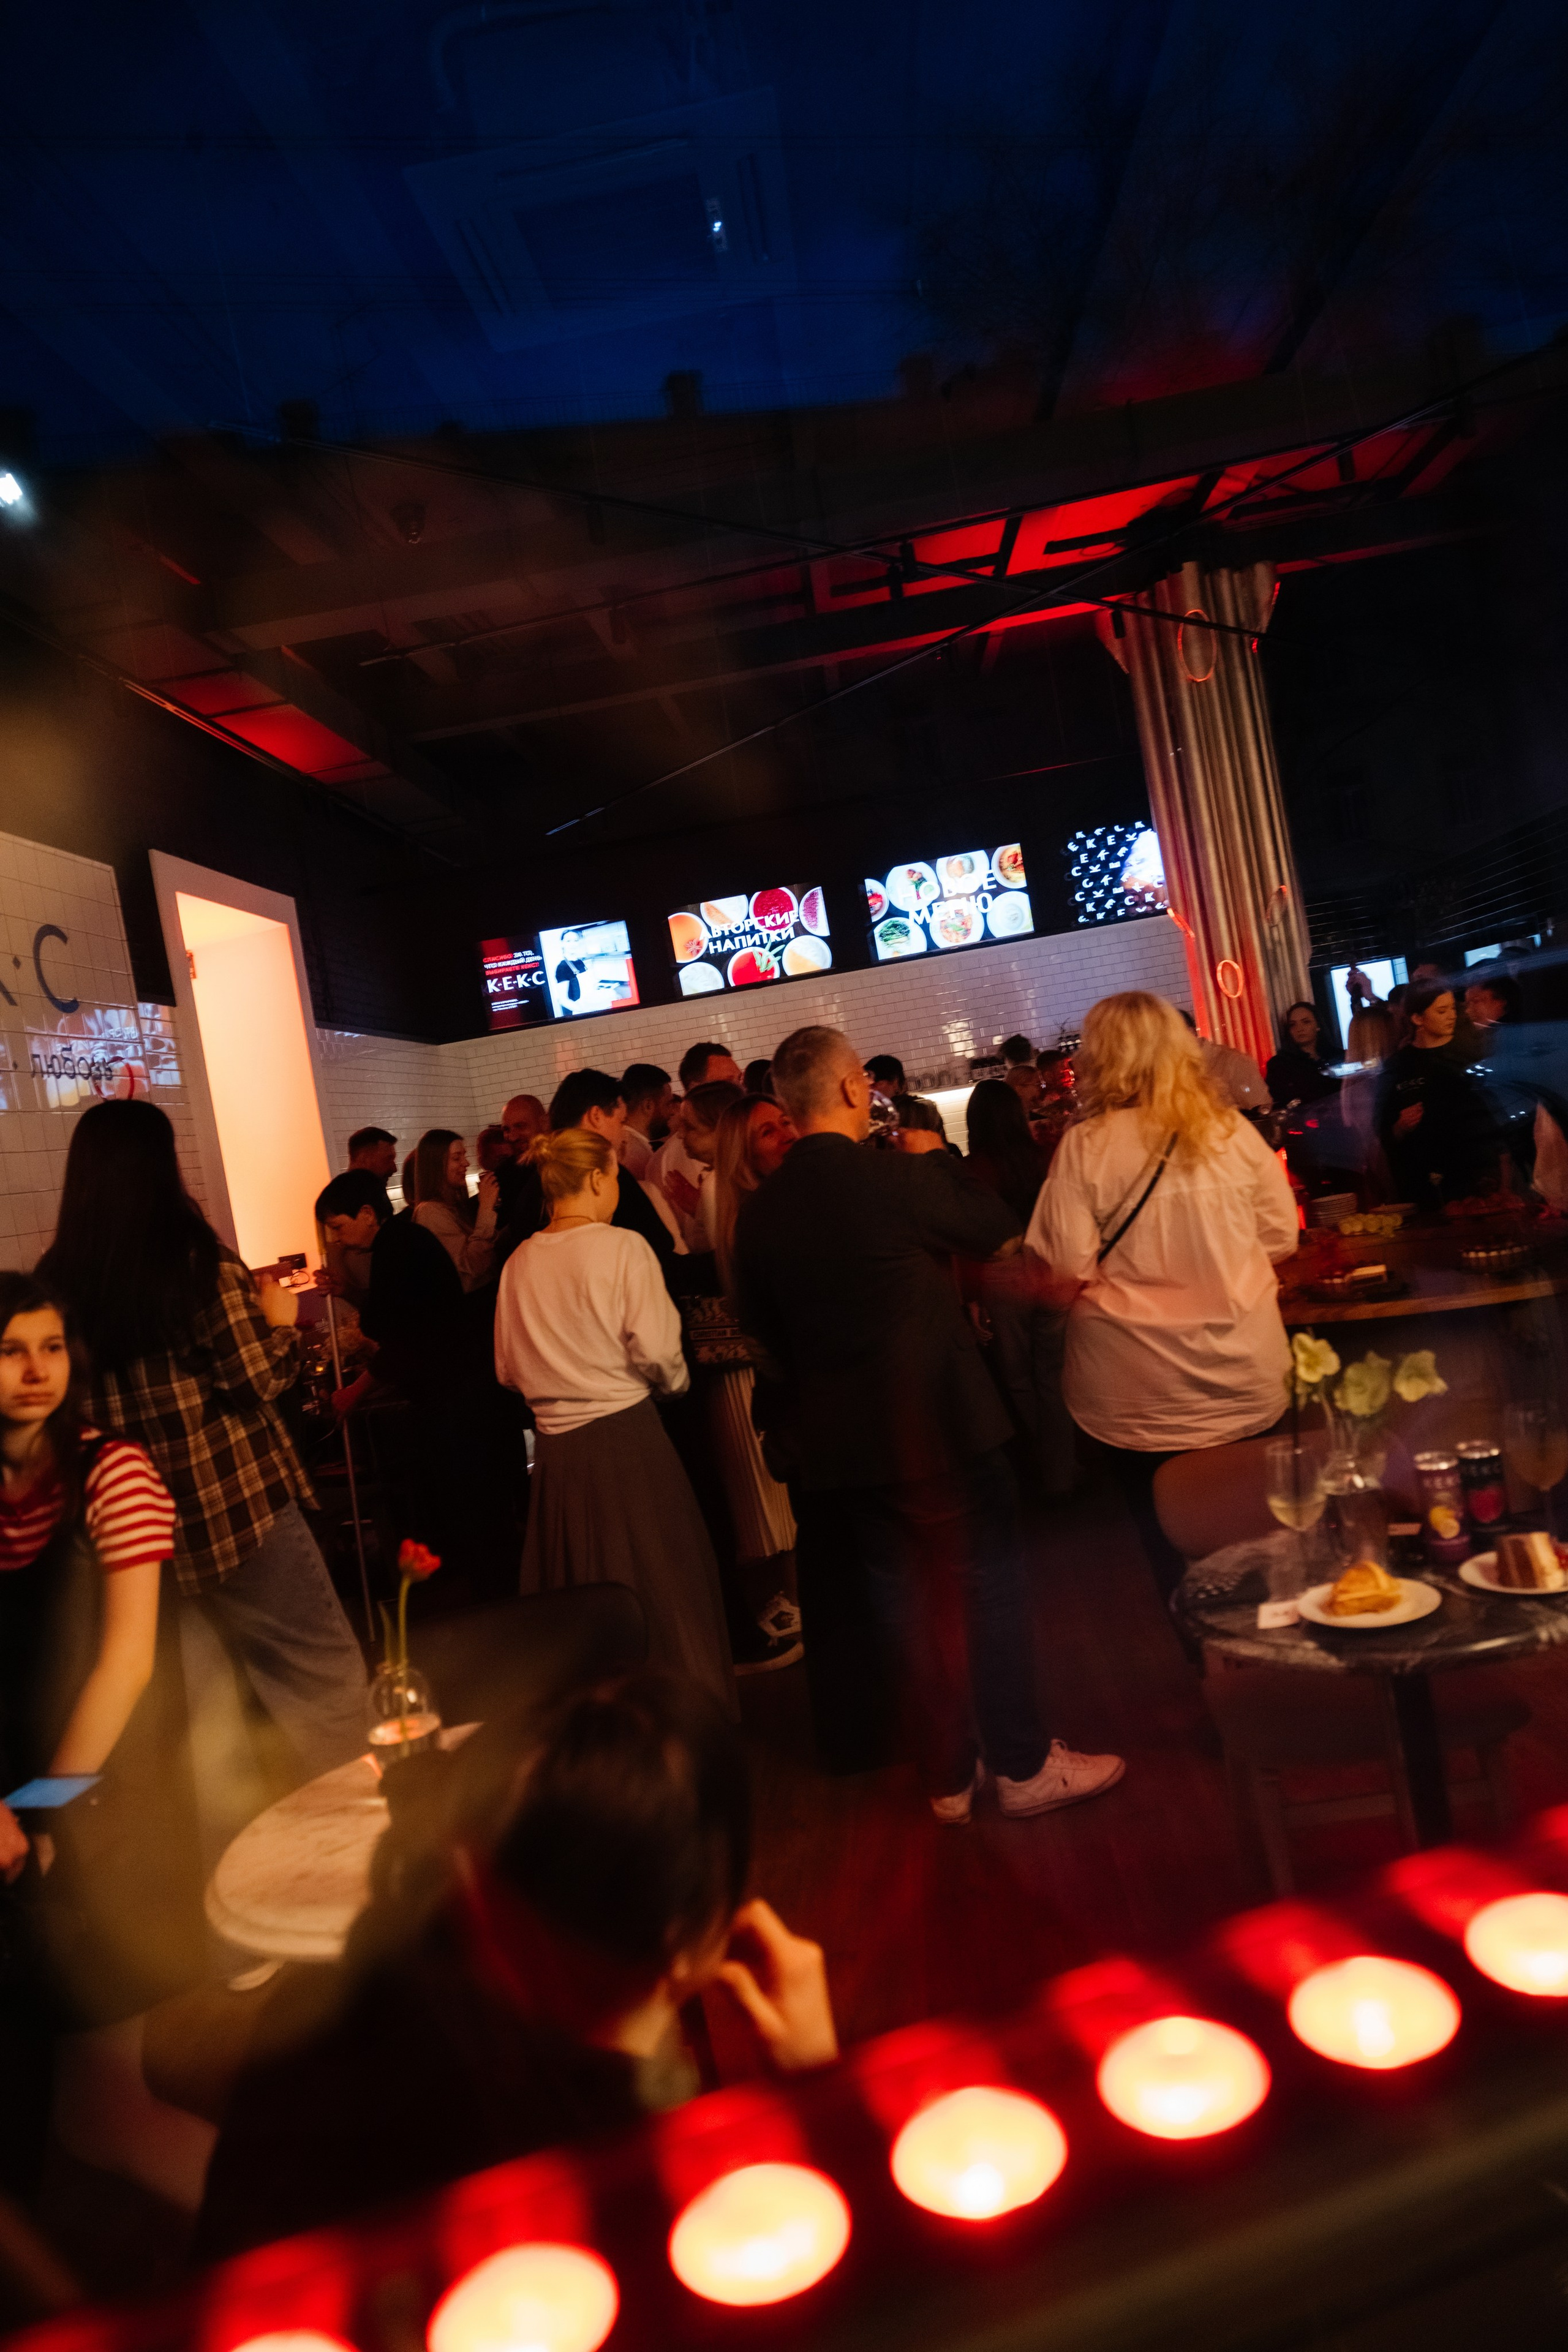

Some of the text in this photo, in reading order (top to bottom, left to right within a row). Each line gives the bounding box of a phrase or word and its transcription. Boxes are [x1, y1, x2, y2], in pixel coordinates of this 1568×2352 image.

[897, 869, 997, 906] НОВОЕ
[909, 892, 993, 925] МЕНЮ
[699, 910, 800, 940] АВТОРСКИЕ
[708, 927, 795, 954] НАПИТКИ
[483, 954, 513, 963] СПАСИБО
[485, 965, 521, 975] ВЫБИРАЕТЕ
[498, 957, 526, 967] КАЖДЫЙ
